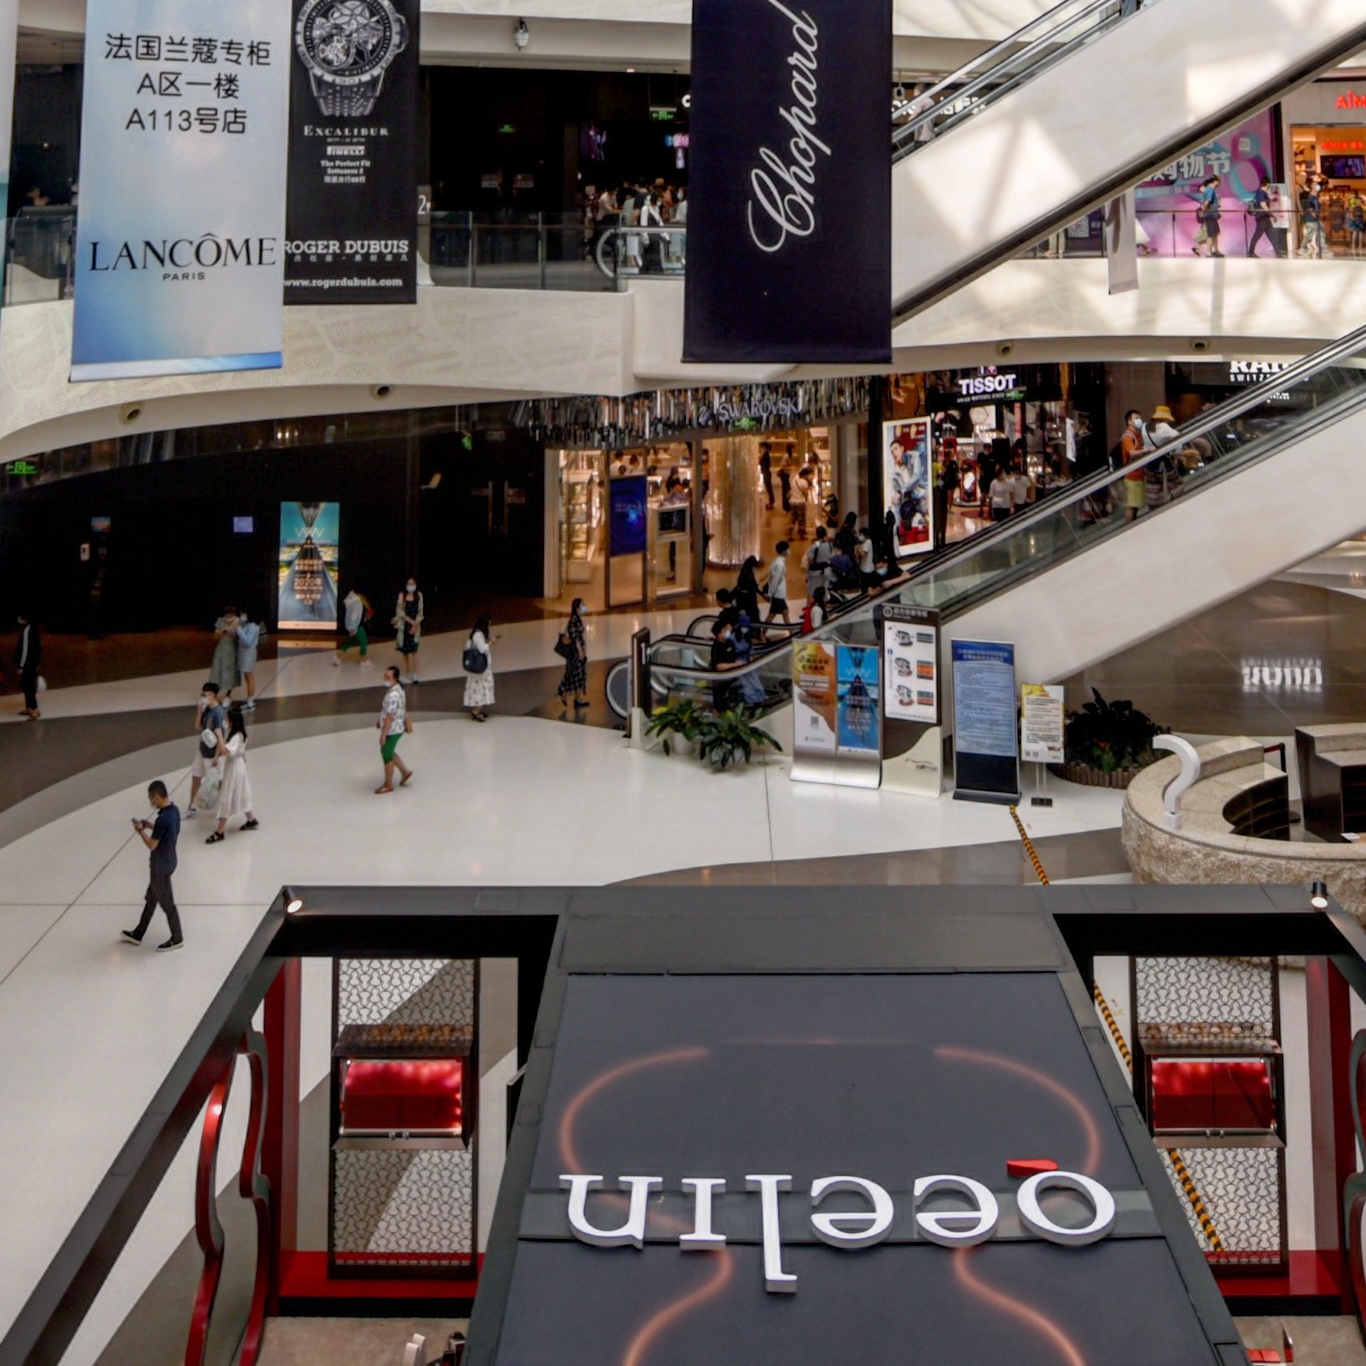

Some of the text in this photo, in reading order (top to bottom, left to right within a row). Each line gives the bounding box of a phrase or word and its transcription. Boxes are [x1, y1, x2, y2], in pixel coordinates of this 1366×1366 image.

[104, 33, 272, 67] 法国兰蔻专柜
[136, 71, 240, 100] A区一楼
[125, 108, 248, 135] A113号店
[304, 125, 389, 136] EXCALIBUR
[89, 233, 277, 272] LANCÔME
[284, 240, 409, 253] ROGER DUBUIS
[163, 272, 206, 281] PARIS
[283, 277, 403, 289] www.rogerdubuis.com
[958, 374, 1016, 395] TISSOT
